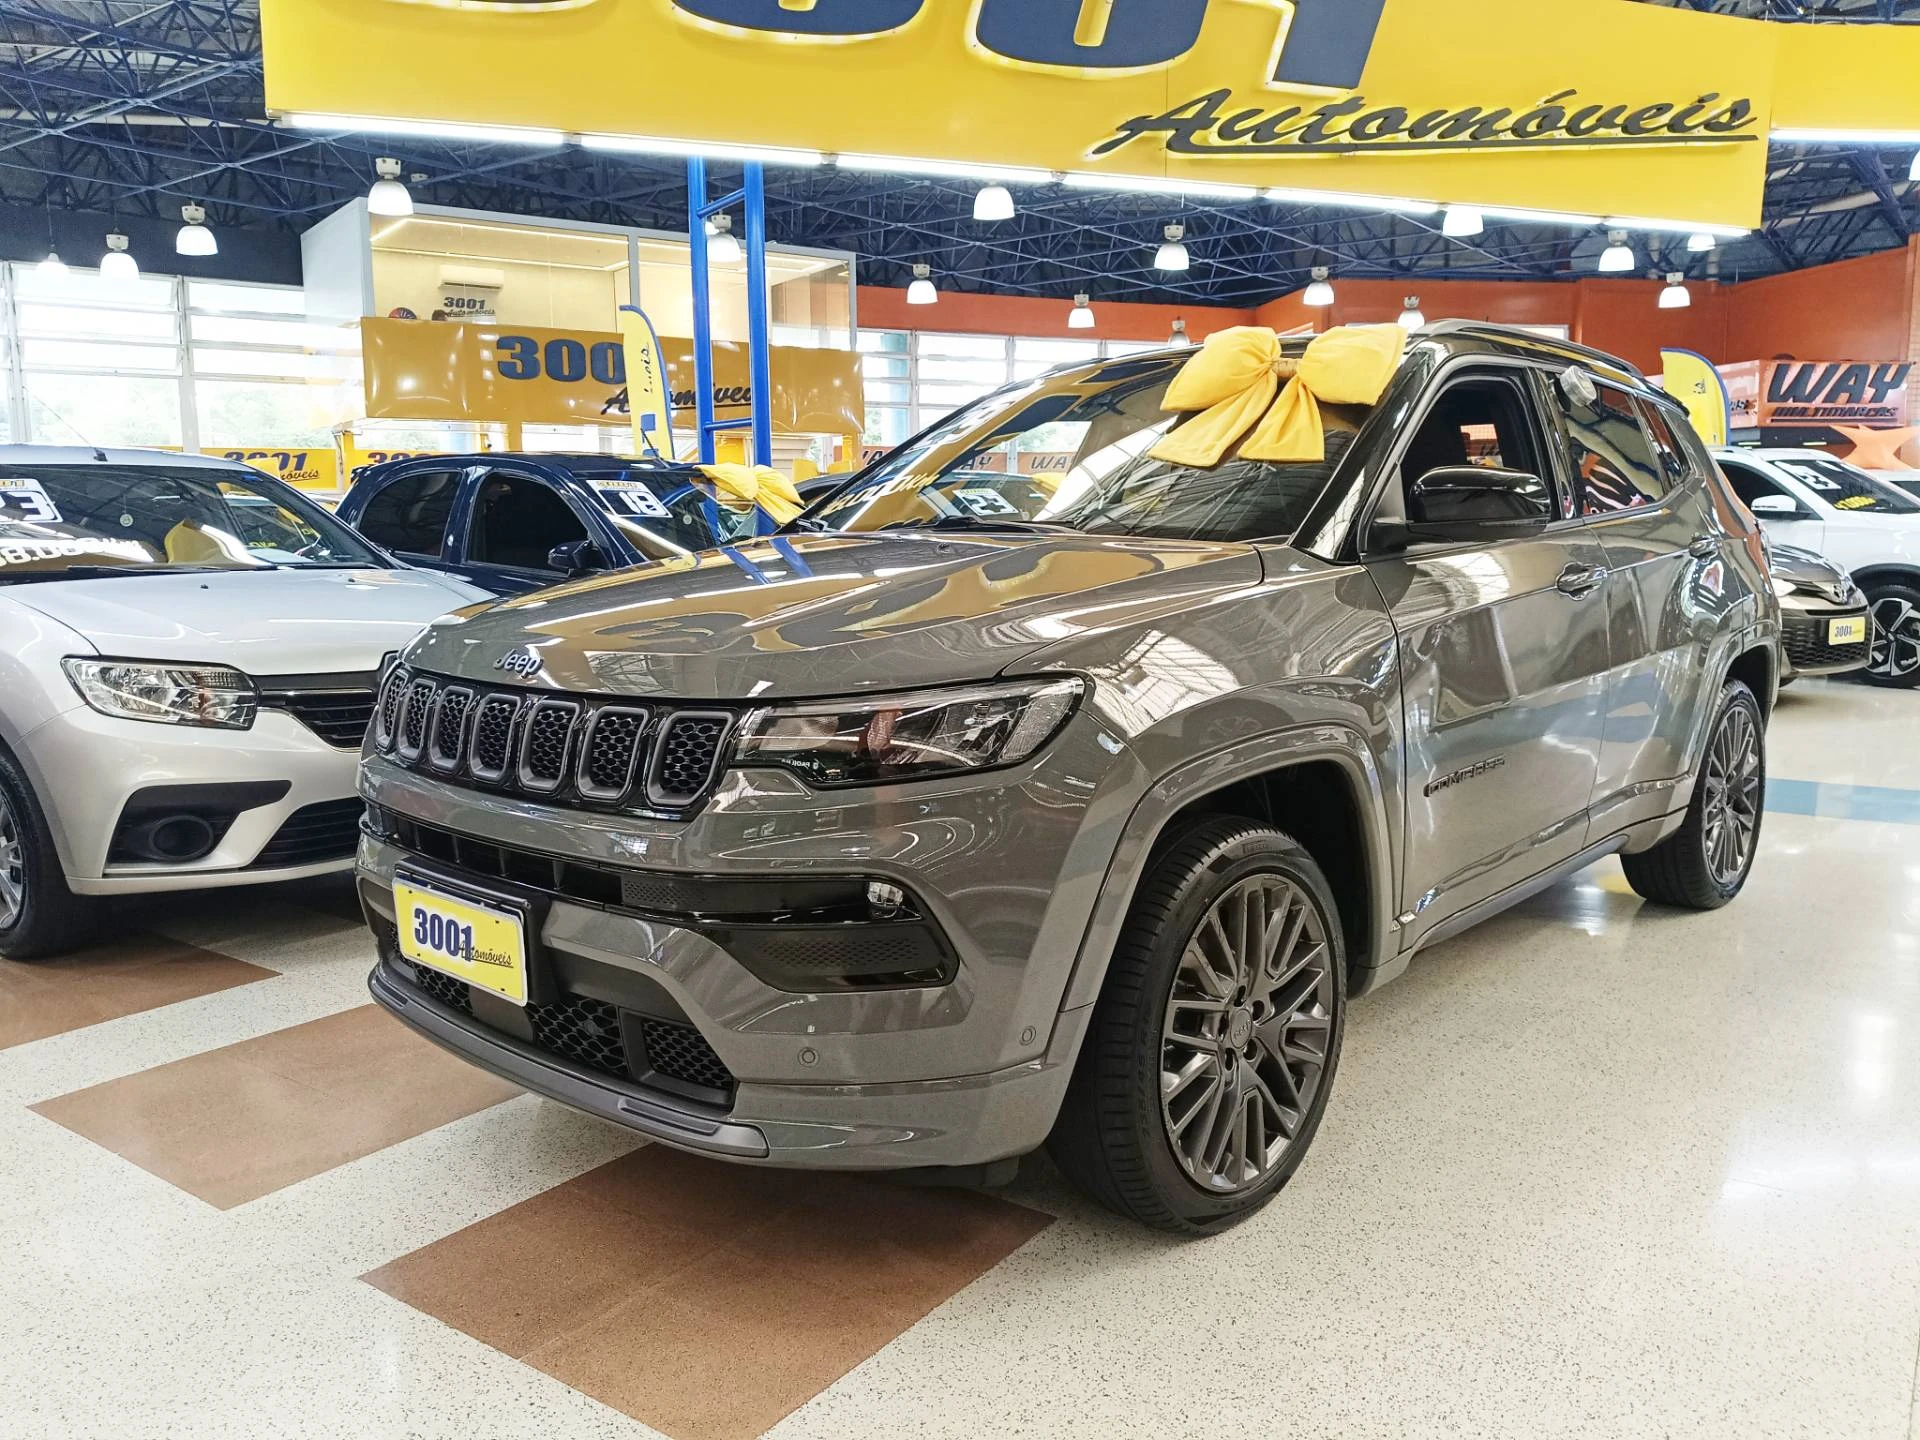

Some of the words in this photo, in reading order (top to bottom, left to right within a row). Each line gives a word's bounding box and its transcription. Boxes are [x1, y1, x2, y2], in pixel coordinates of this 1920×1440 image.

[1092, 88, 1759, 155] Automóveis
[443, 296, 486, 310] 3001
[496, 335, 627, 385] 300
[1767, 363, 1911, 404] WAY
[619, 490, 669, 516] 18
[961, 493, 1013, 514] 23
[493, 648, 543, 679] Jeep
[414, 907, 472, 962] 3001
[459, 940, 514, 968] Automóveis
